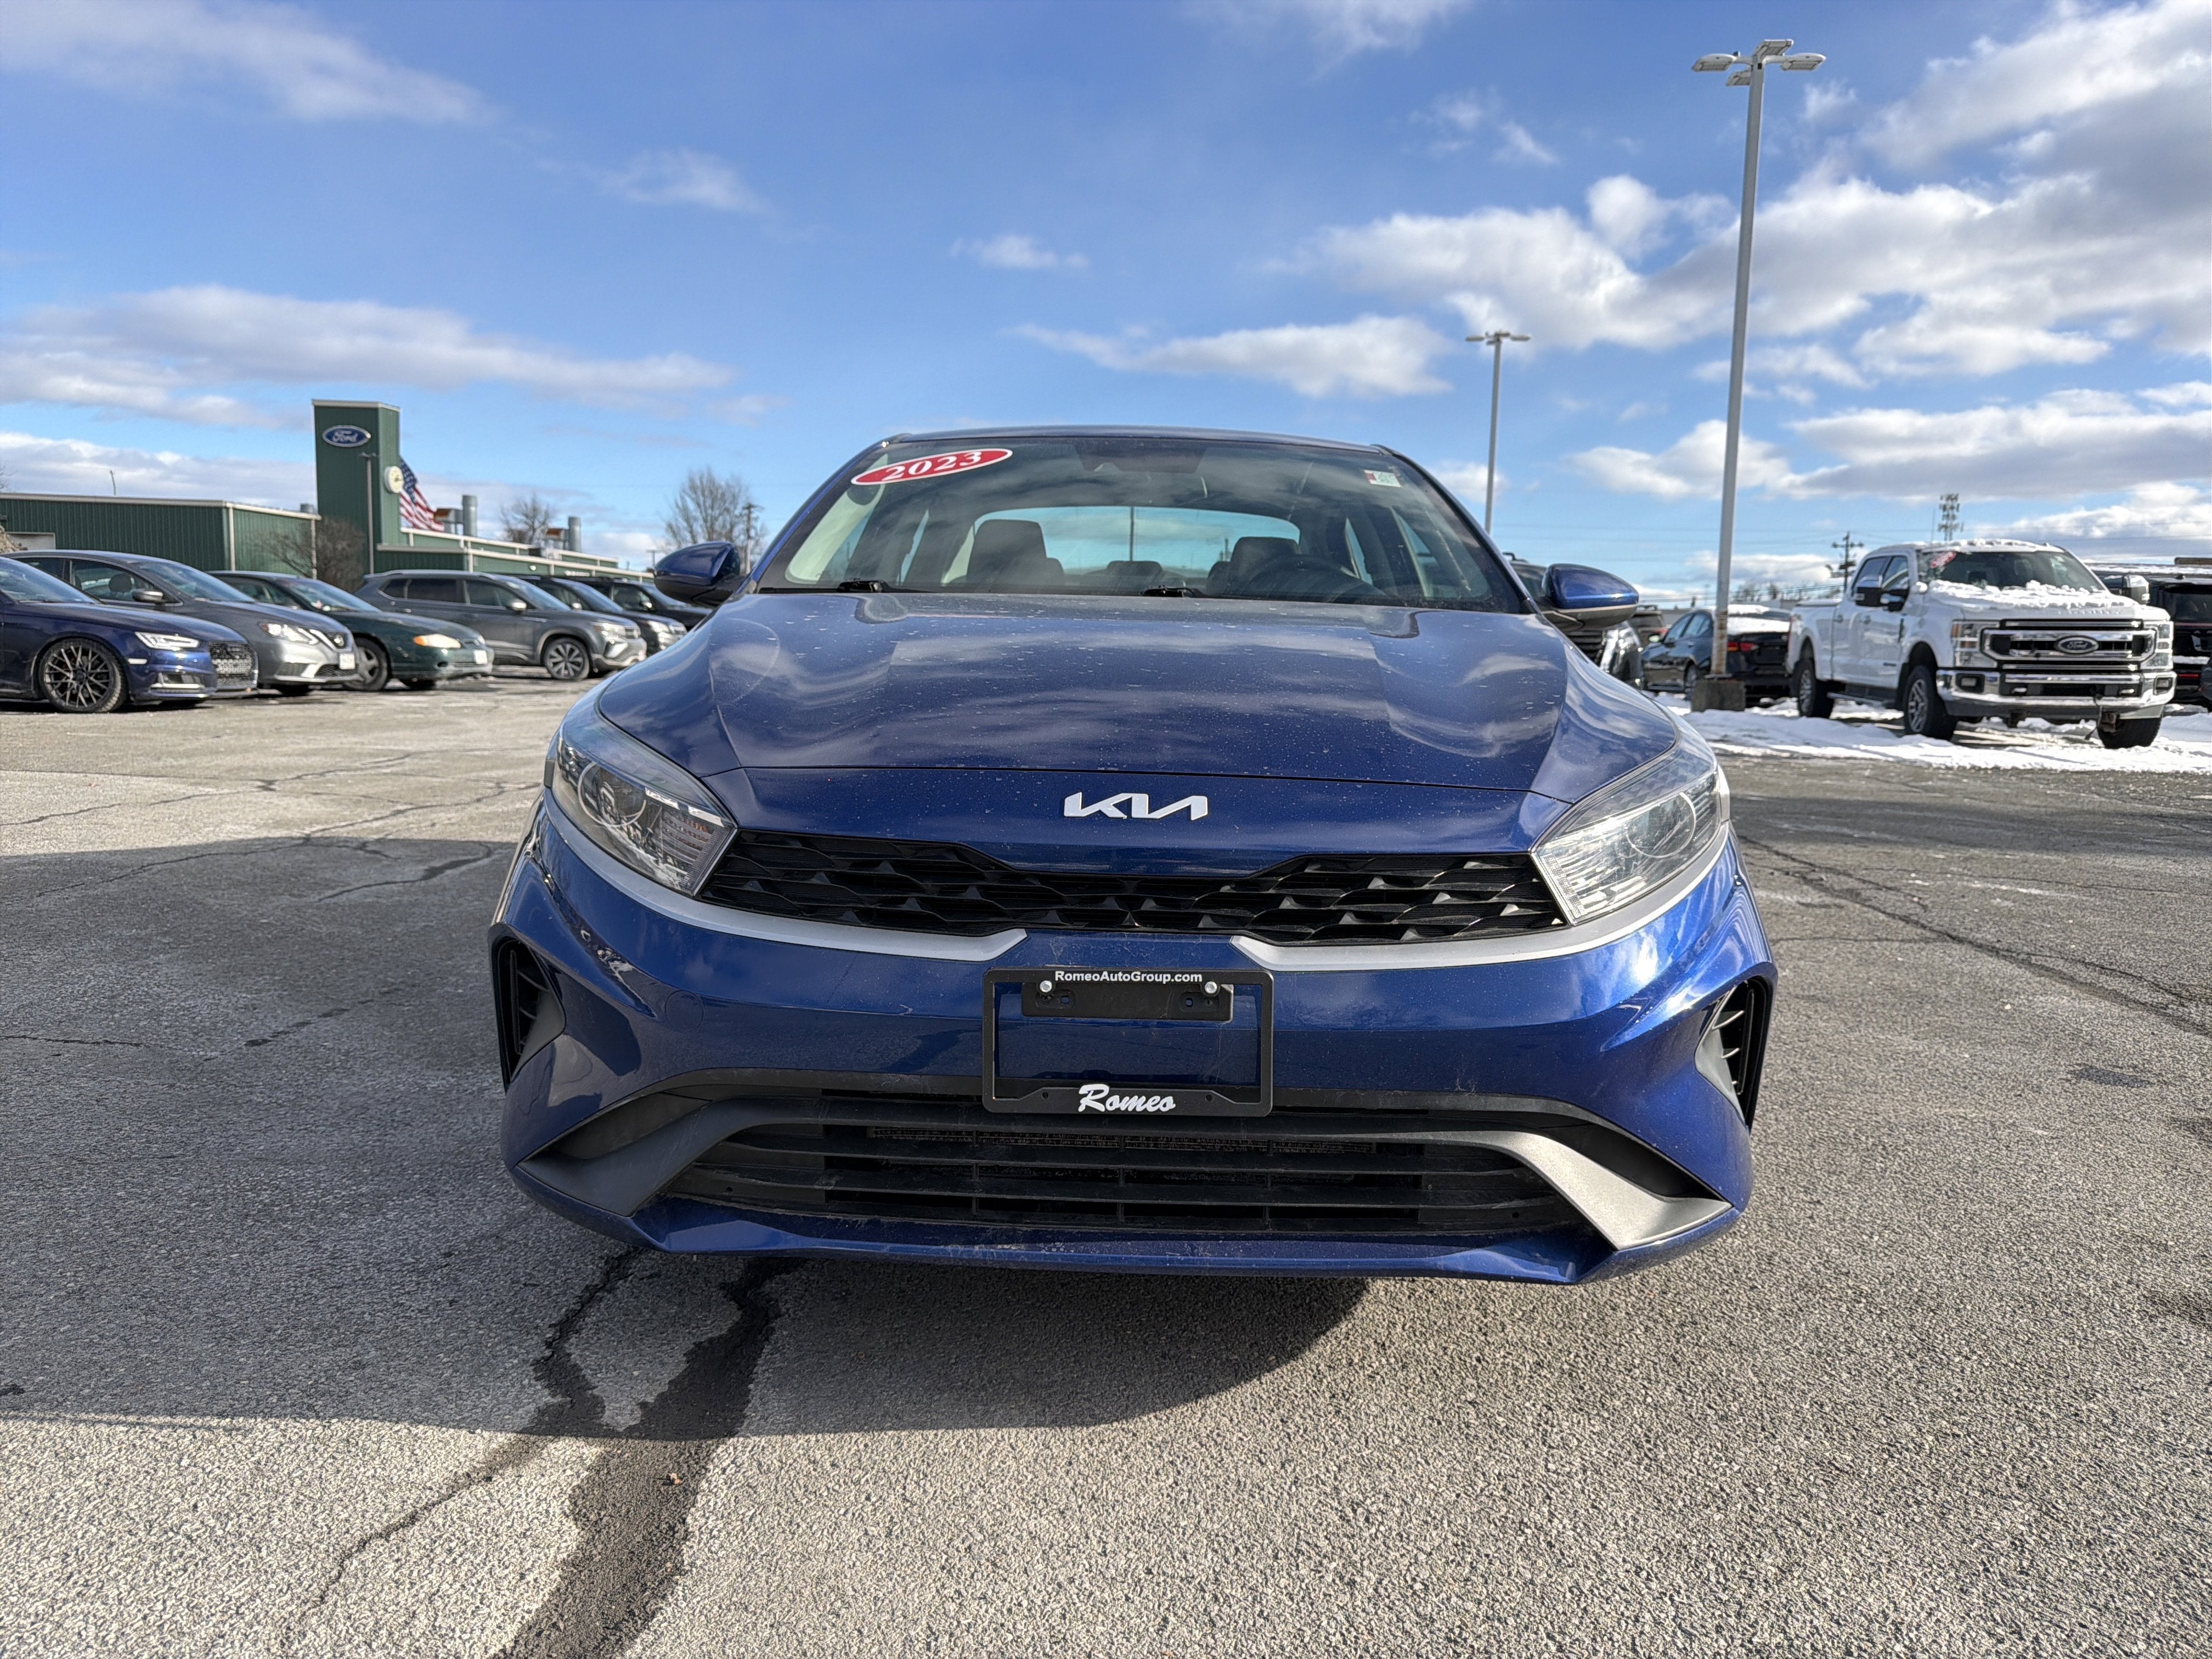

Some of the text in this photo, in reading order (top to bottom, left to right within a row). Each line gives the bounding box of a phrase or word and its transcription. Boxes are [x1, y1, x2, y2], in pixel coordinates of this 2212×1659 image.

[332, 430, 358, 442] Ford
[882, 452, 982, 481] 2023
[1064, 792, 1208, 820] KIA
[1055, 971, 1203, 984] RomeoAutoGroup.com
[1078, 1084, 1176, 1112] Romeo
